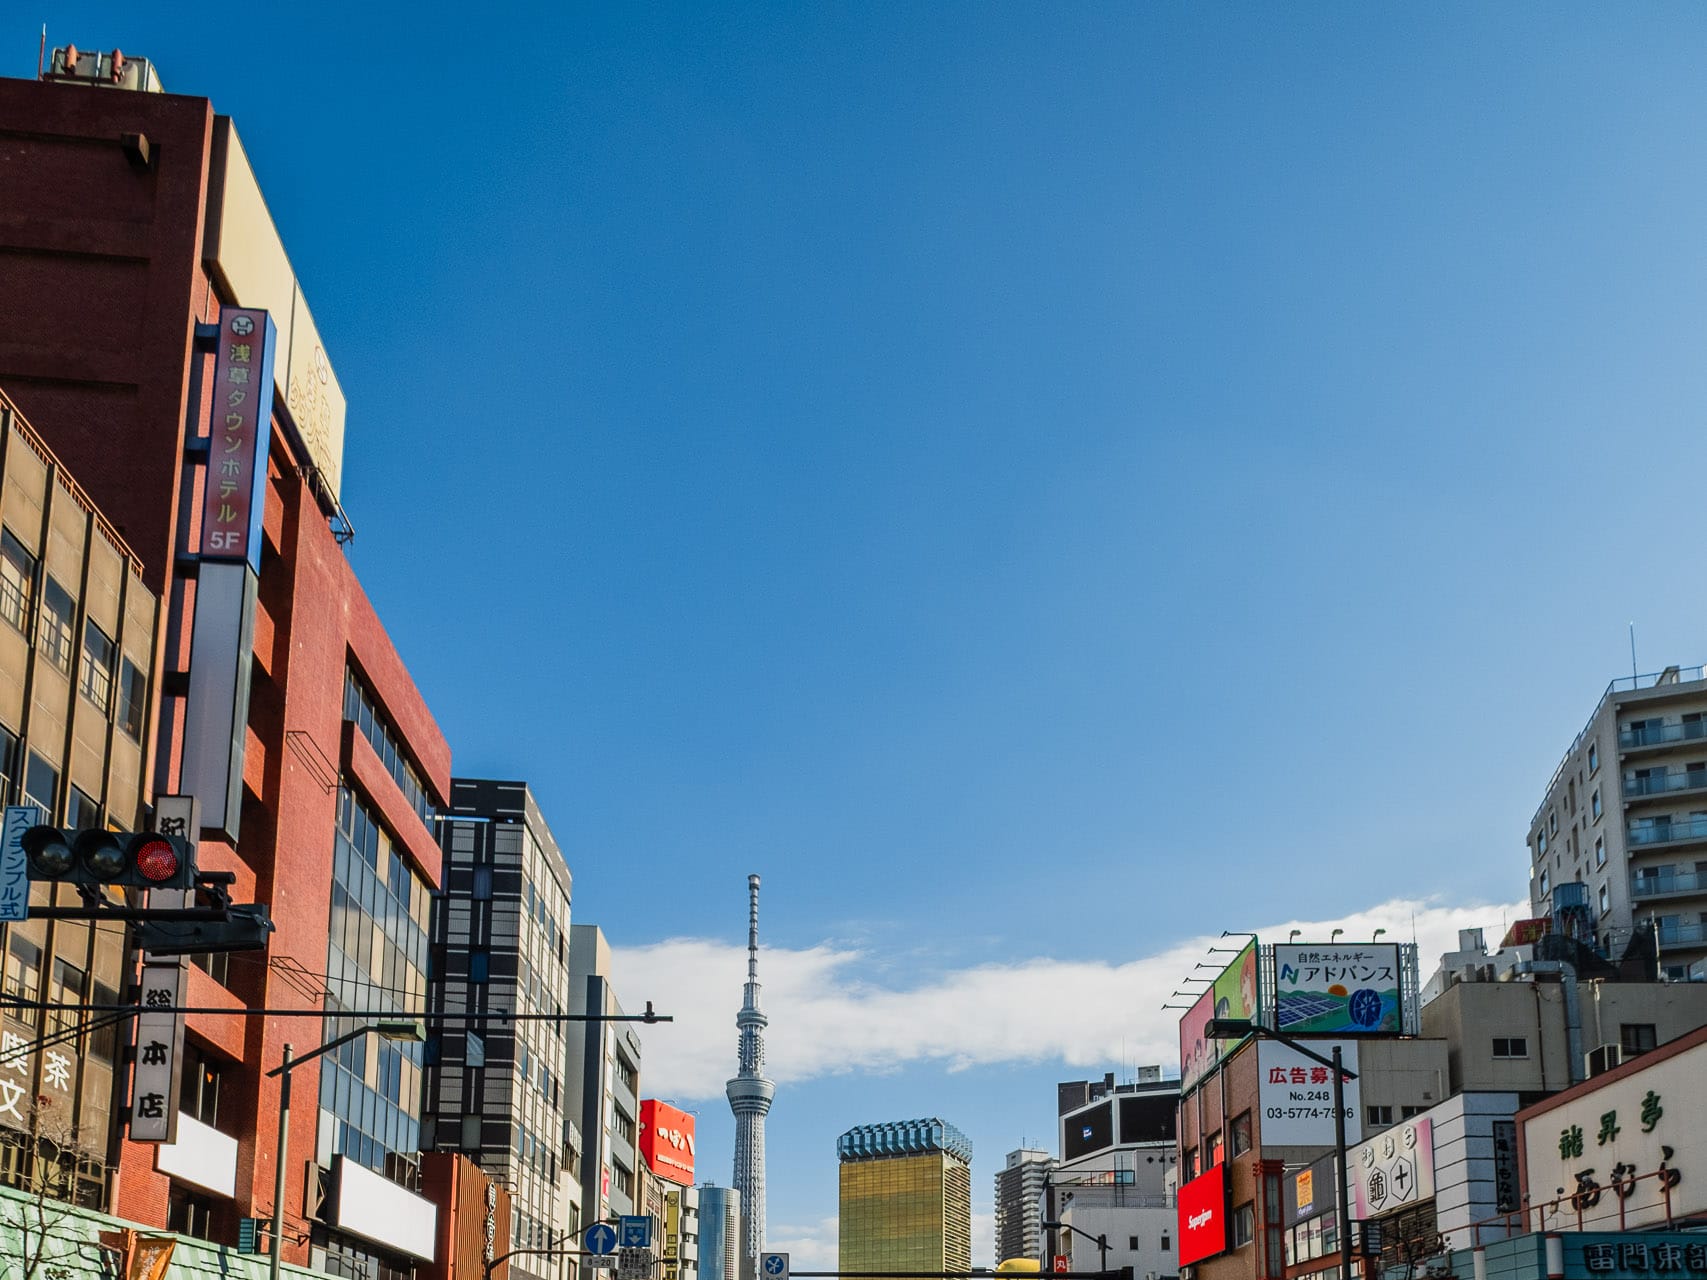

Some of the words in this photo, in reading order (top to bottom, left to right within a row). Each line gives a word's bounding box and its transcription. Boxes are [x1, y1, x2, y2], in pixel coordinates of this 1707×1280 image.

[217, 343, 252, 524] 浅草タウンホテル
[209, 531, 241, 550] 5F
[1297, 951, 1375, 964] 自然エネルギー
[1304, 966, 1394, 983] アドバンス
[1268, 1066, 1351, 1085] 広告募
[1289, 1091, 1330, 1101] No.248
[1266, 1107, 1354, 1119] 03-5774-756
[587, 1258, 611, 1267] 8-20
